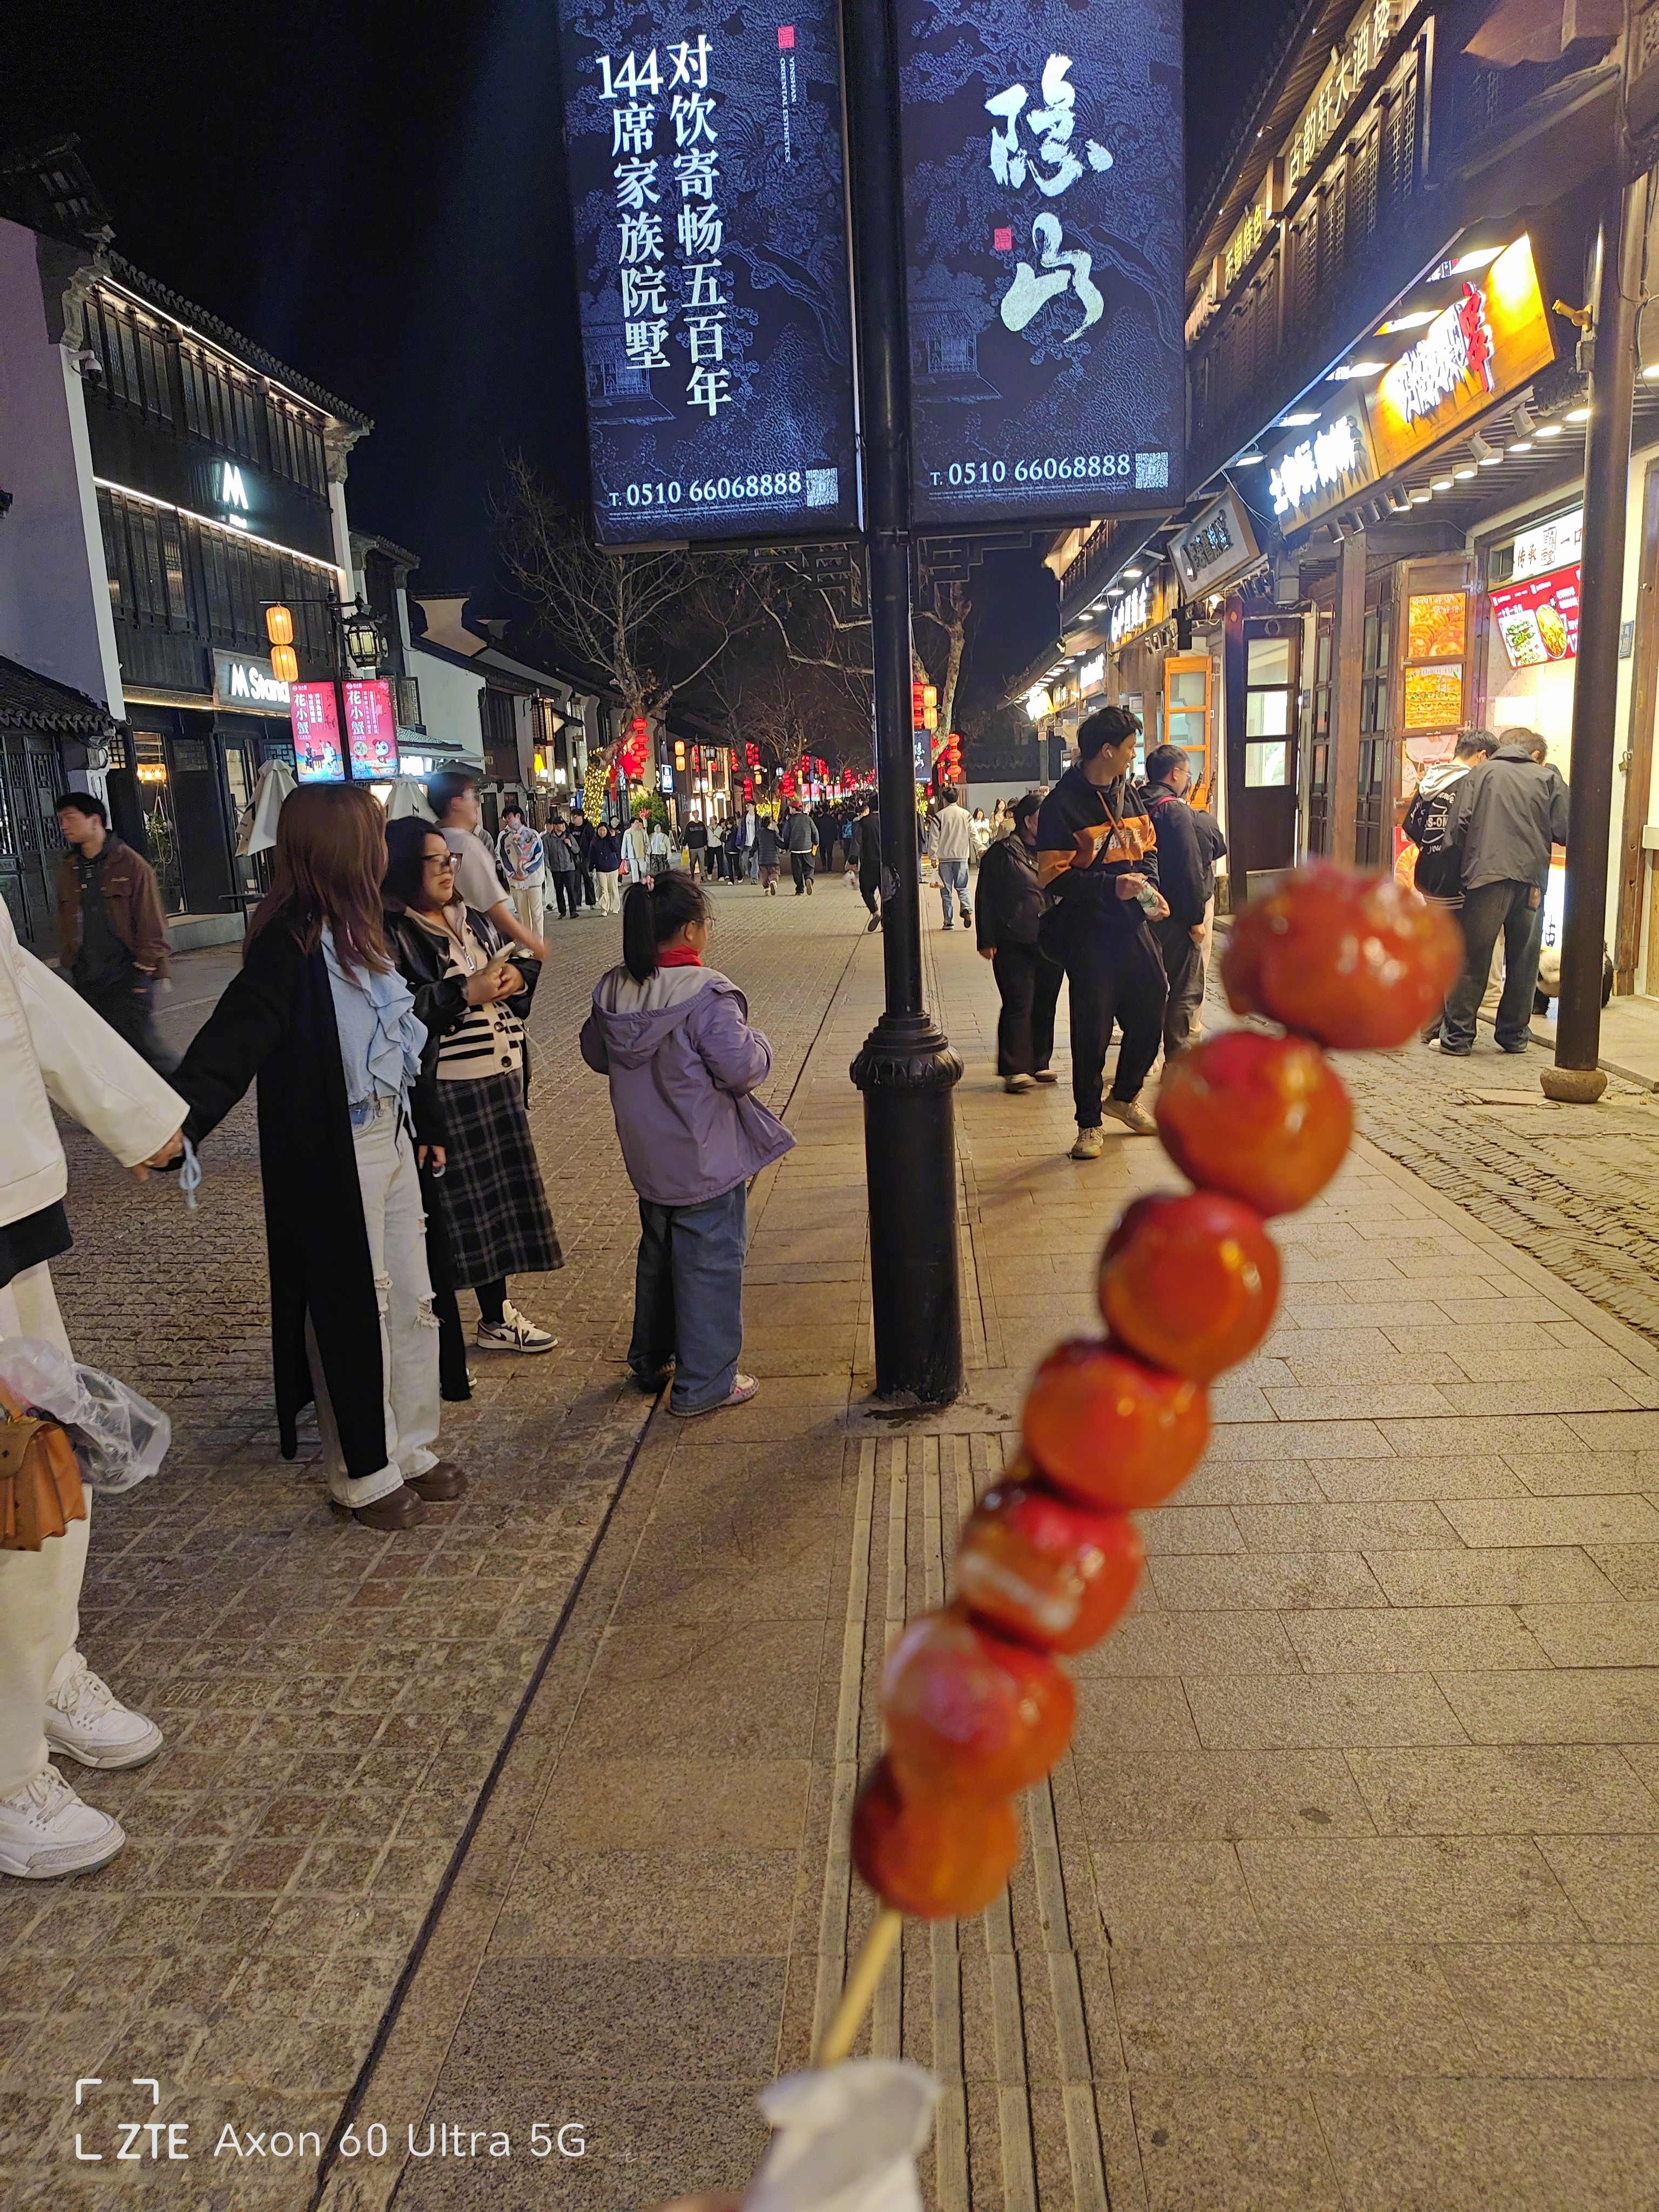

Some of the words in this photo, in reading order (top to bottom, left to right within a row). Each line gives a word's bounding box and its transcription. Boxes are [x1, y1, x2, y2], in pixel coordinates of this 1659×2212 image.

[780, 57, 788, 108] ORIENTAL
[783, 109, 791, 163] ESTHETICS
[596, 48, 670, 370] 144席家族院墅
[667, 34, 731, 416] 对饮寄畅五百年
[626, 481, 681, 506] 0510
[690, 471, 801, 502] 66068888
[948, 460, 1006, 485] 0510
[1014, 454, 1130, 482] 66068888
[232, 663, 249, 698] M
